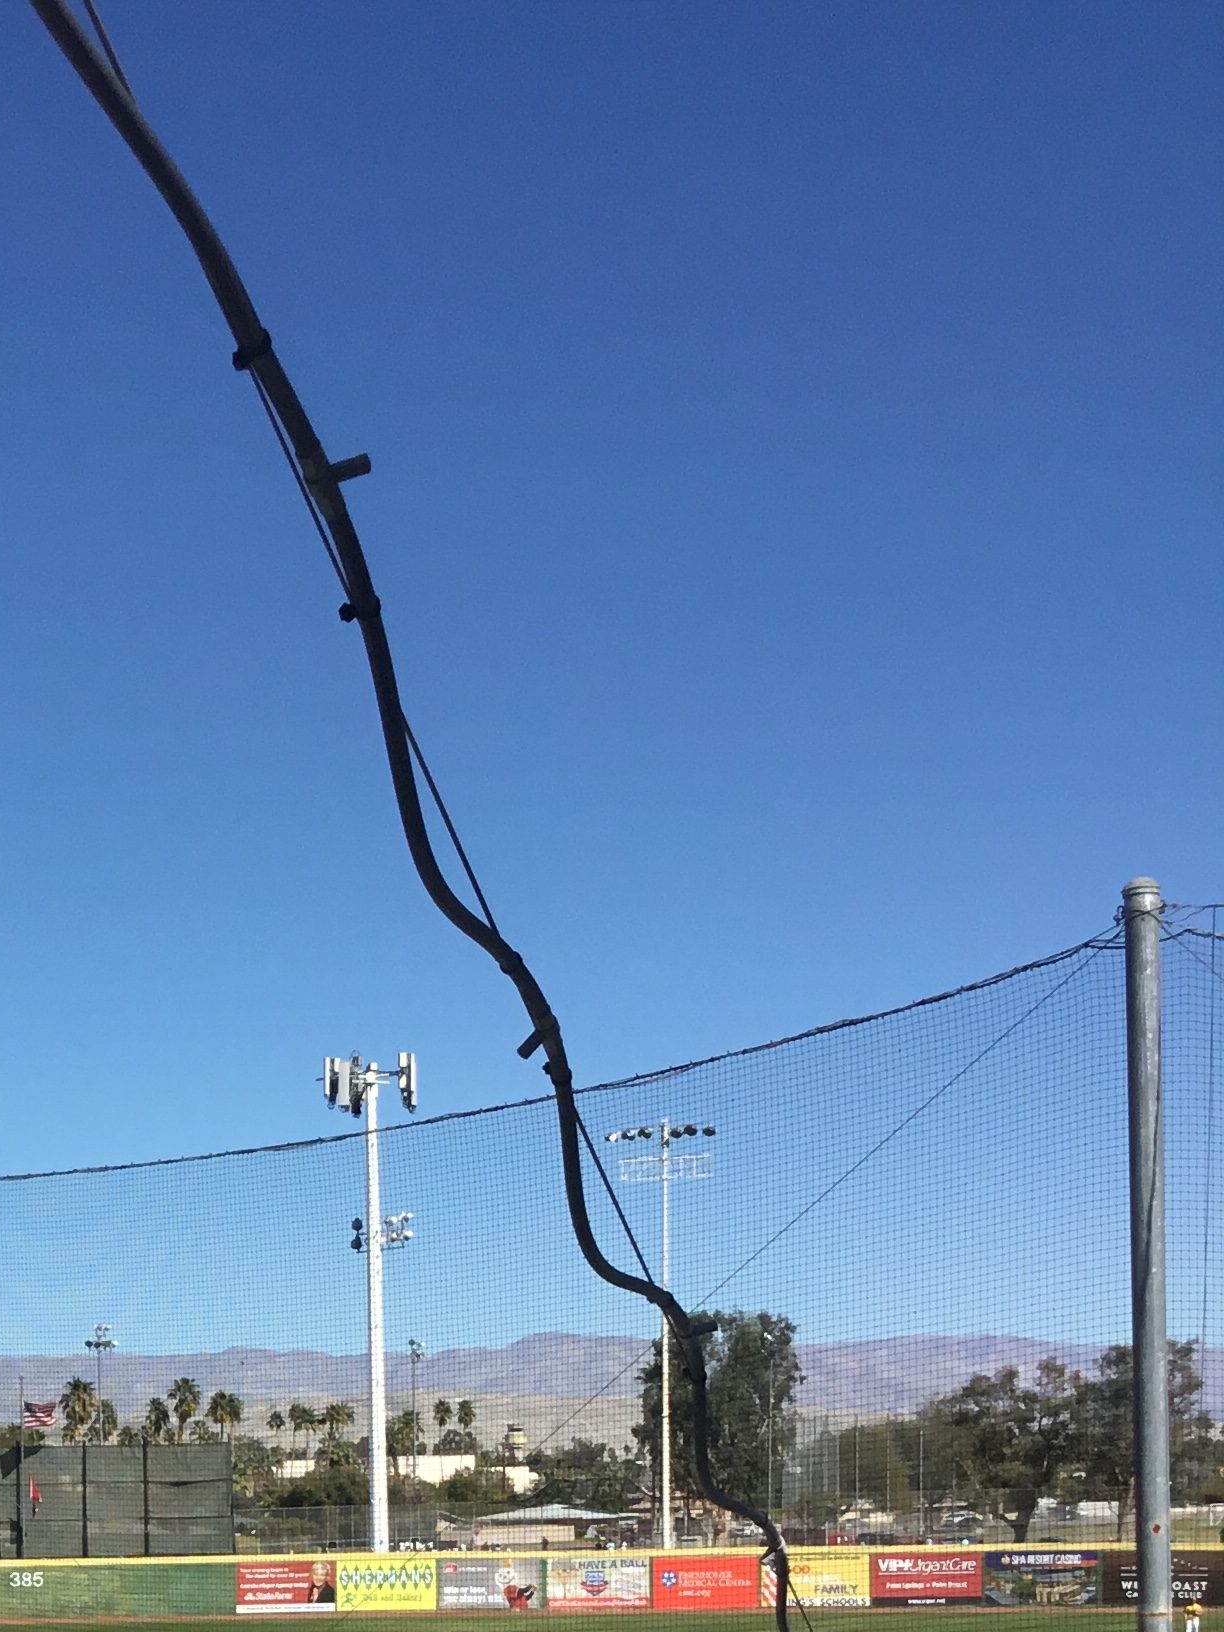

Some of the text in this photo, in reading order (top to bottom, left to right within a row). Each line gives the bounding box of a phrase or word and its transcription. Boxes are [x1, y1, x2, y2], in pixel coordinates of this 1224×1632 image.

[578, 1559, 647, 1570] HAVE A BALL
[9, 1571, 44, 1587] 385
[814, 1584, 859, 1595] FAMILY
[1172, 1581, 1208, 1590] OAST
[788, 1597, 867, 1607] ING'S SCHOOLS
